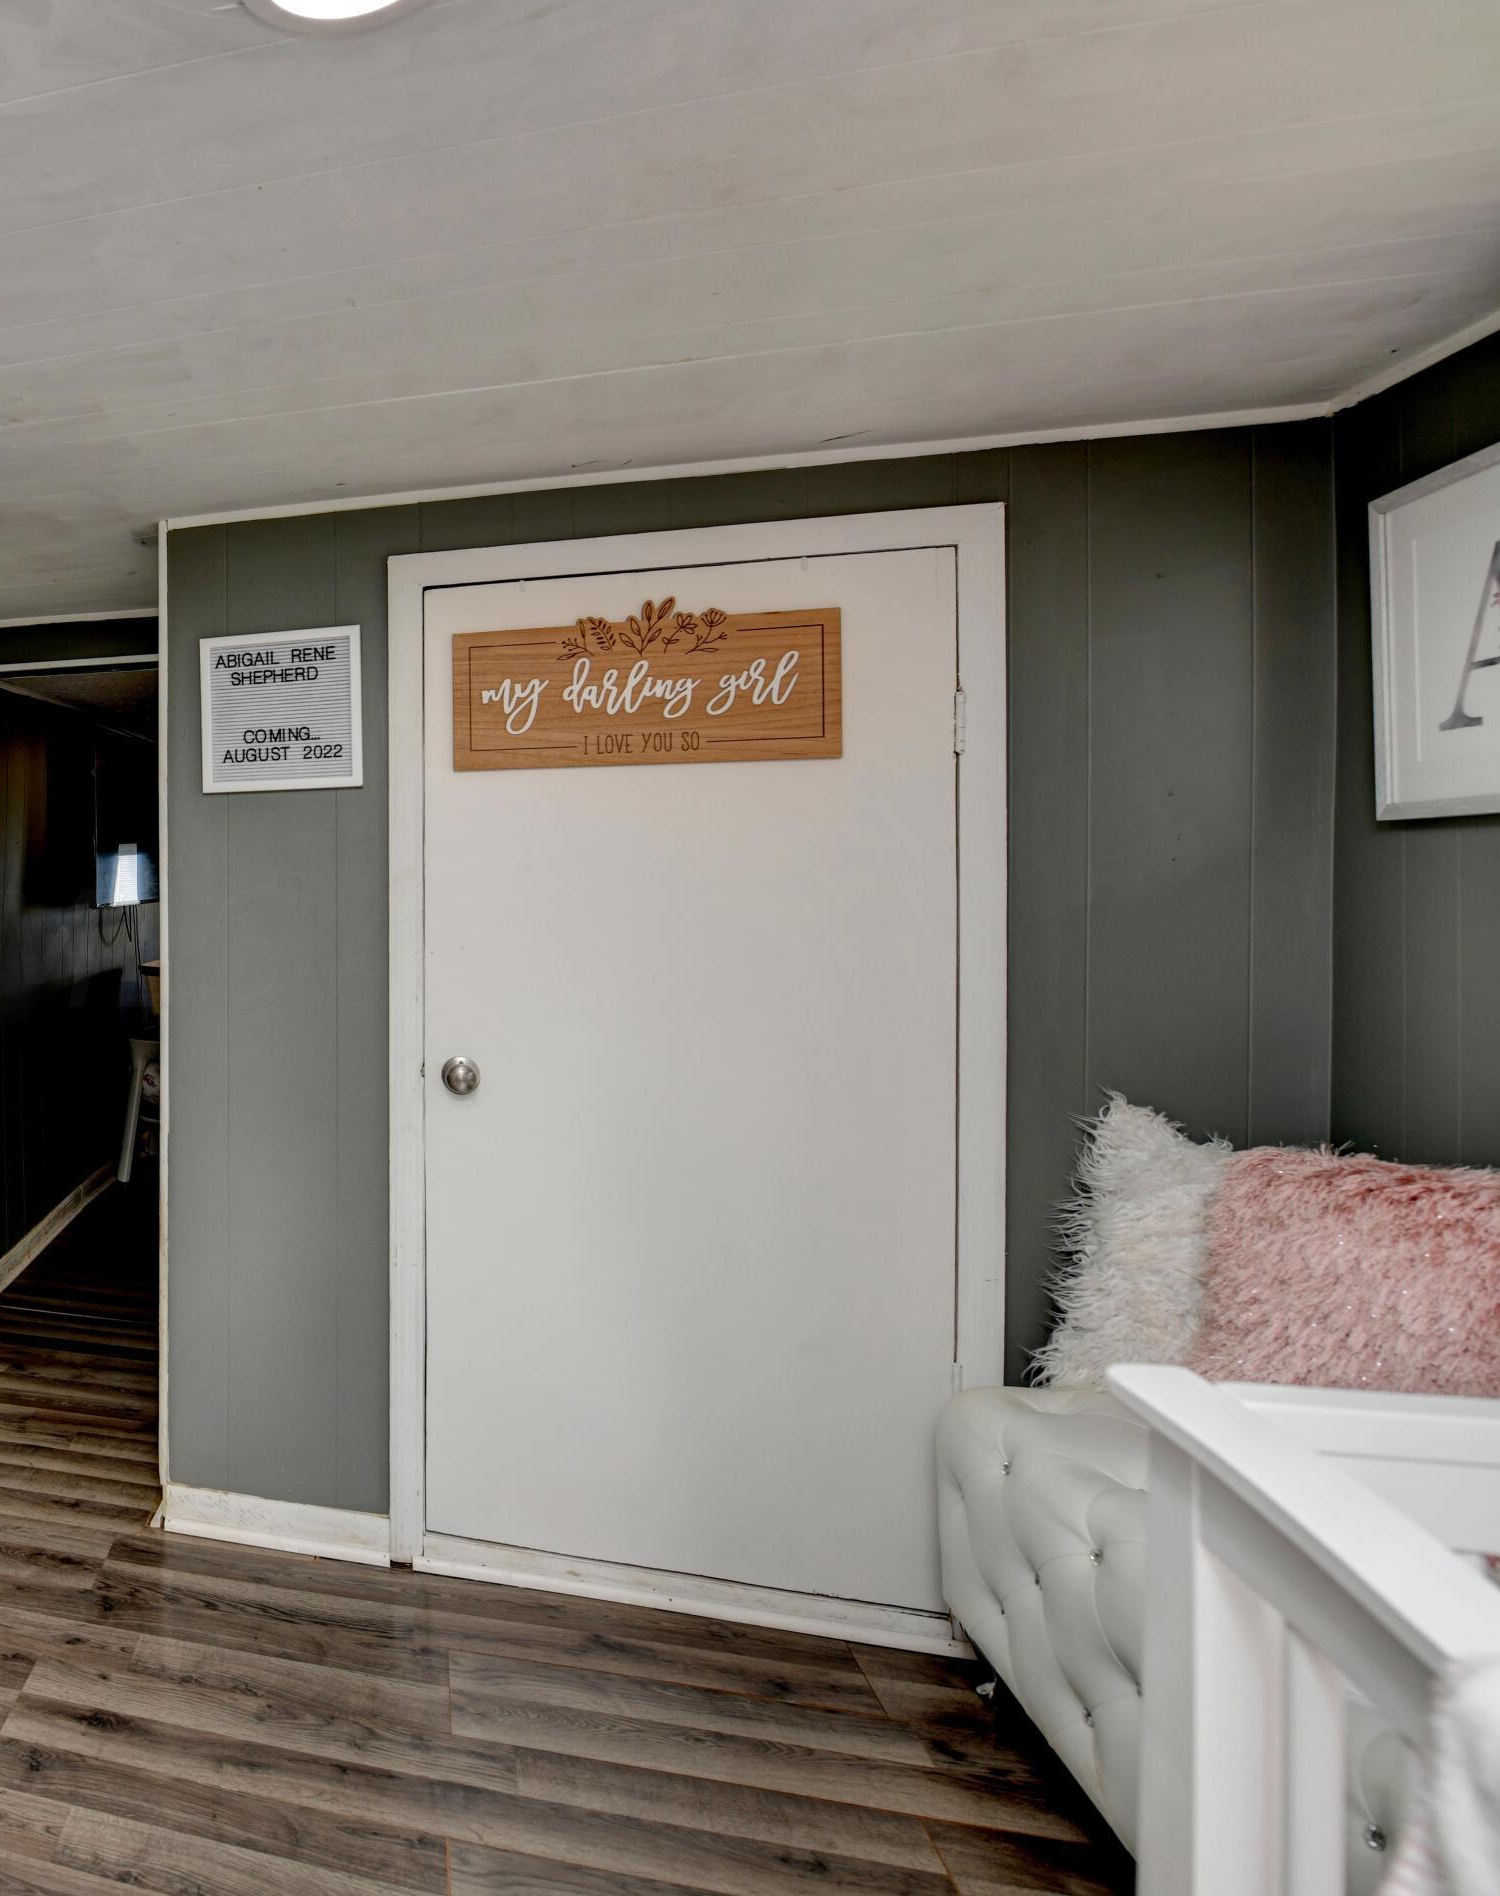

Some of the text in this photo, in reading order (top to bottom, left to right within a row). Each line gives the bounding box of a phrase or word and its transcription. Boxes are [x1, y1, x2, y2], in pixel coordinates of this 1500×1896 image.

[215, 645, 337, 669] ABIGAIL RENE
[230, 666, 319, 686] SHEPHERD
[481, 650, 800, 735] my darling girl
[222, 744, 343, 763] AUGUST 2022
[582, 731, 701, 755] I LOVE YOU SO
